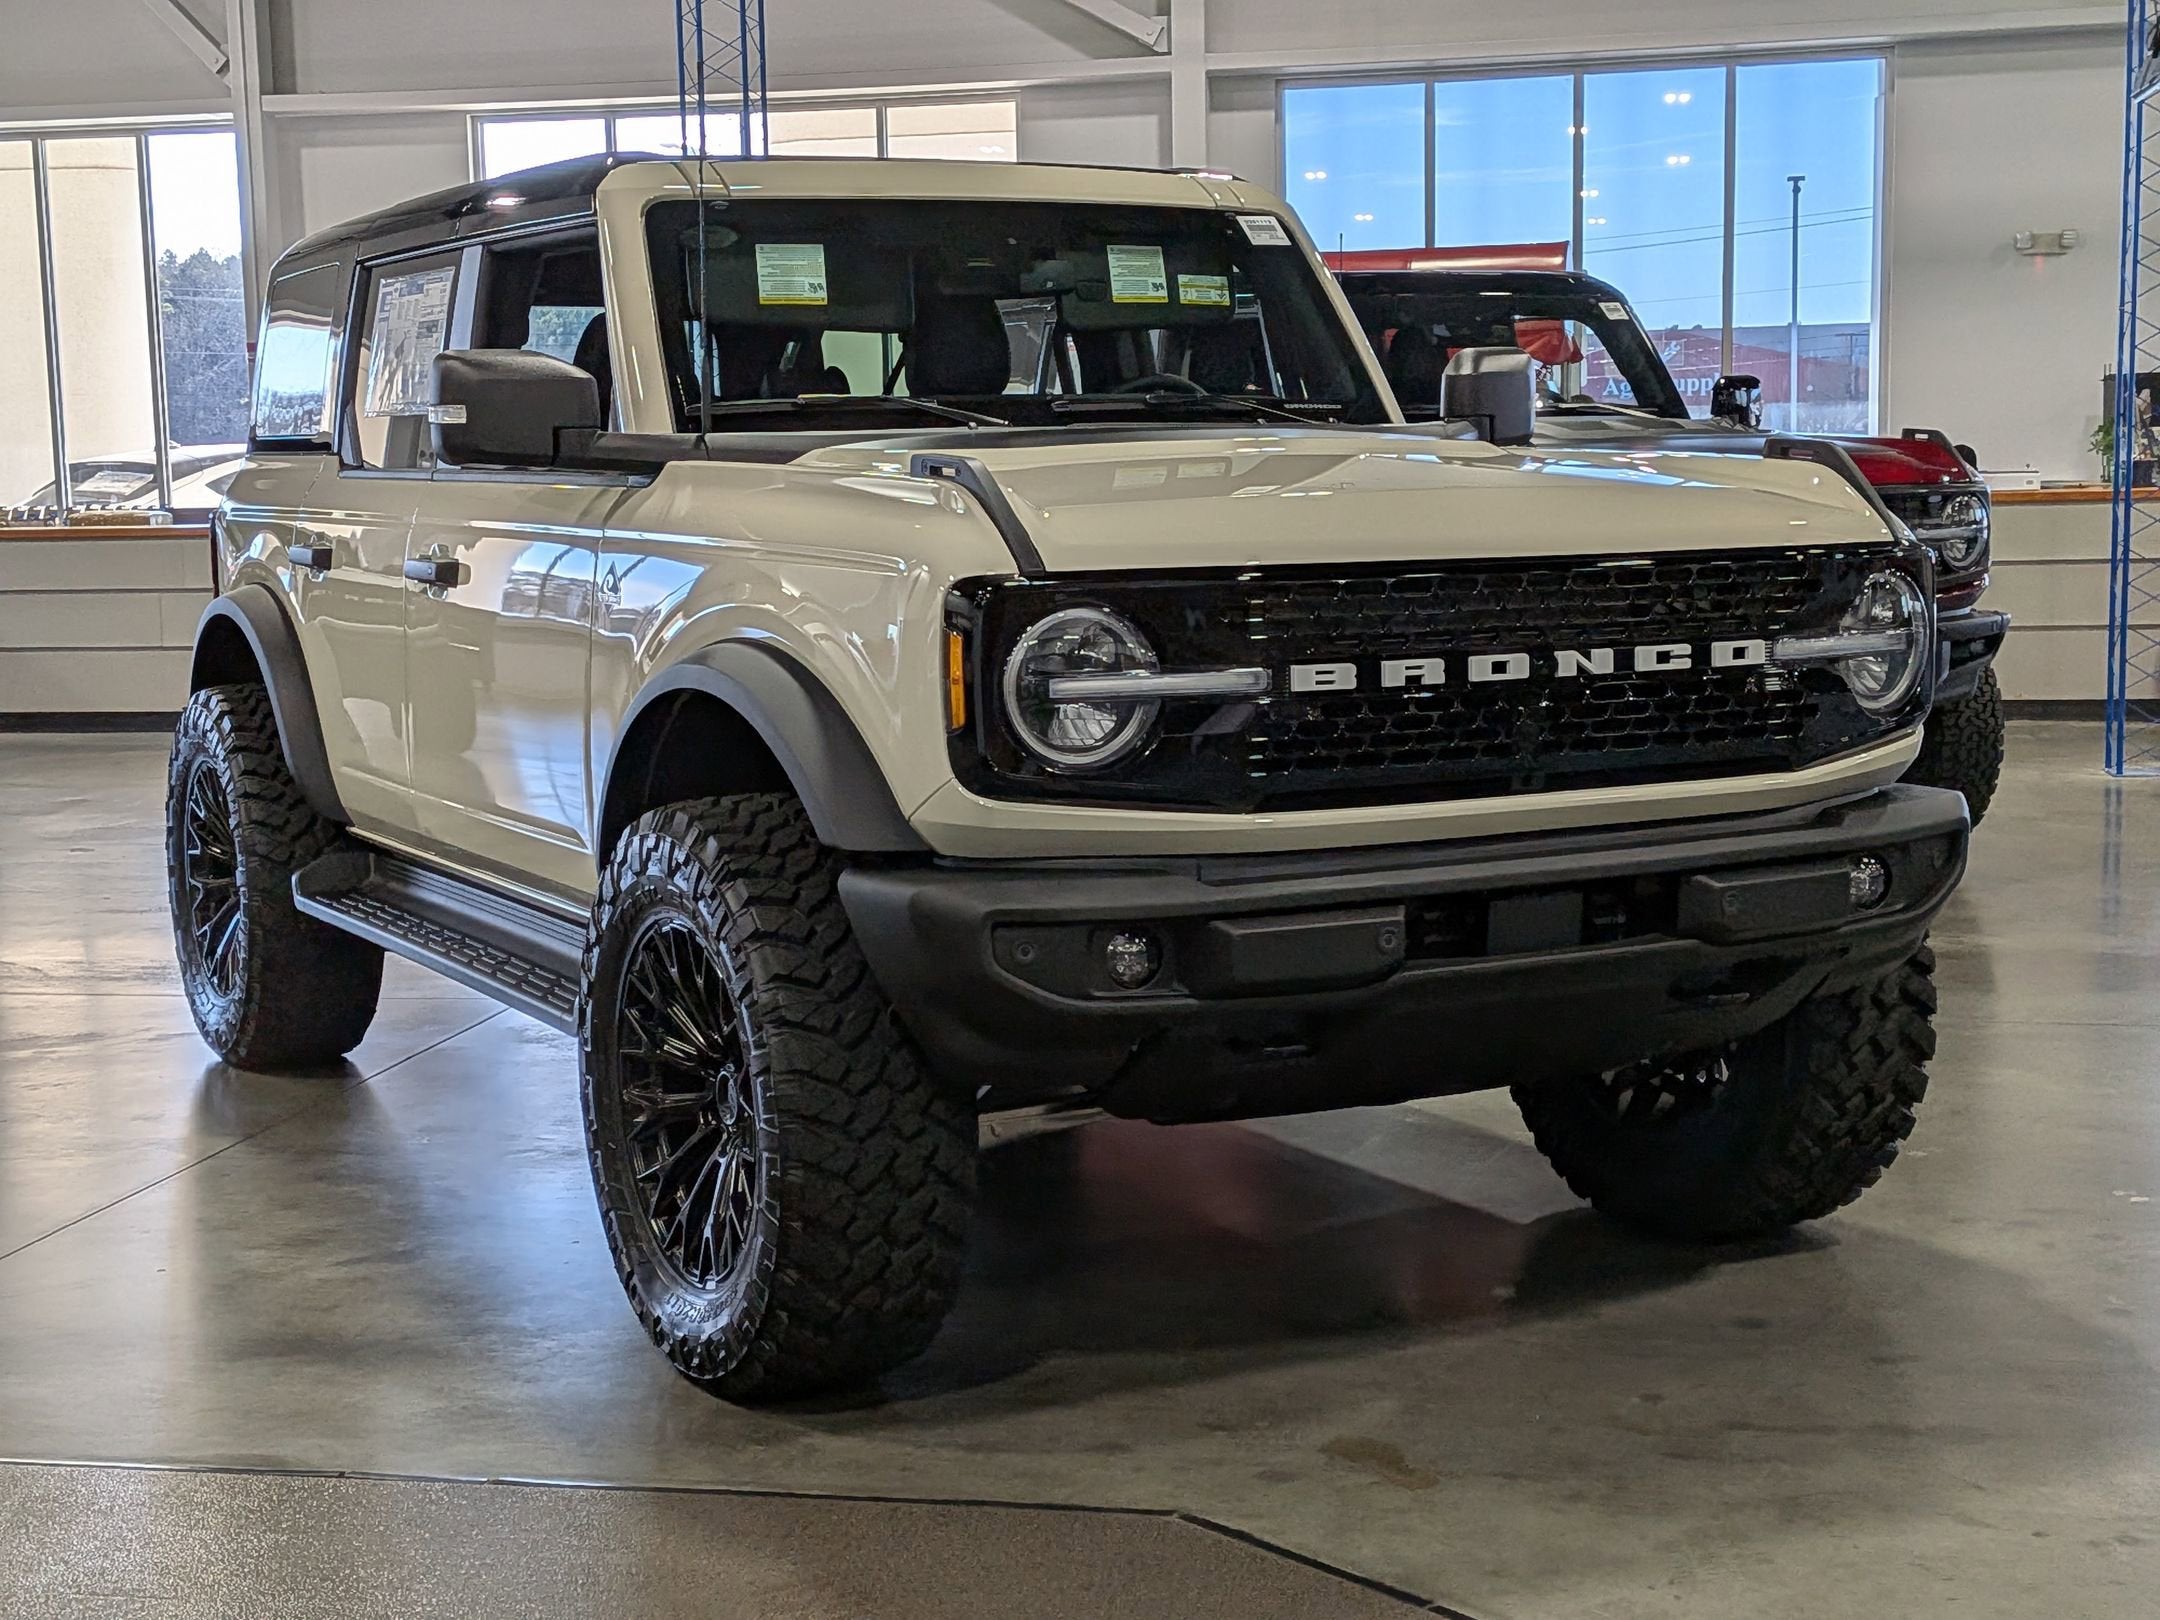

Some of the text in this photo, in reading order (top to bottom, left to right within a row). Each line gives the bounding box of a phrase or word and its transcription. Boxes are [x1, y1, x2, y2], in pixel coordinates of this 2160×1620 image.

[1602, 371, 1720, 400] Ag uppl
[1290, 639, 1767, 692] BRONCO
